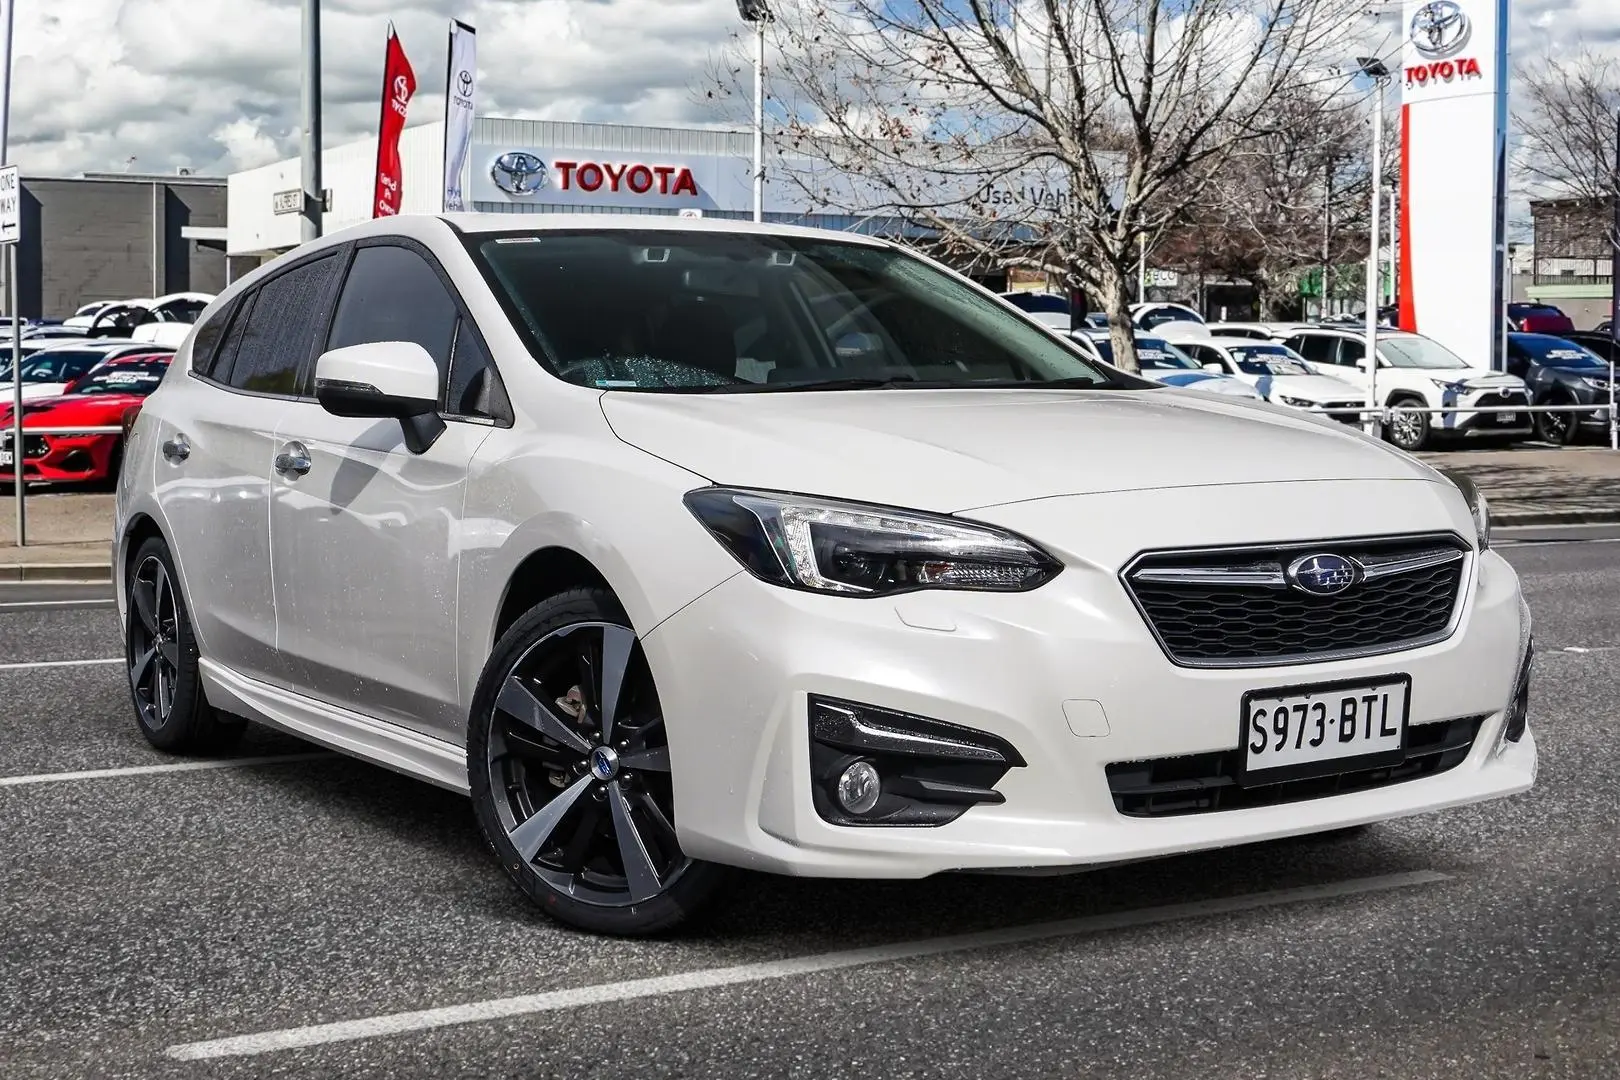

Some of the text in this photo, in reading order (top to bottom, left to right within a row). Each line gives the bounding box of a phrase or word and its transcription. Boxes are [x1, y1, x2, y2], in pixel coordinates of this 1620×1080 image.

[1404, 58, 1481, 83] TOYOTA
[0, 173, 15, 191] ONE
[555, 162, 698, 196] TOYOTA
[0, 196, 16, 214] WAY
